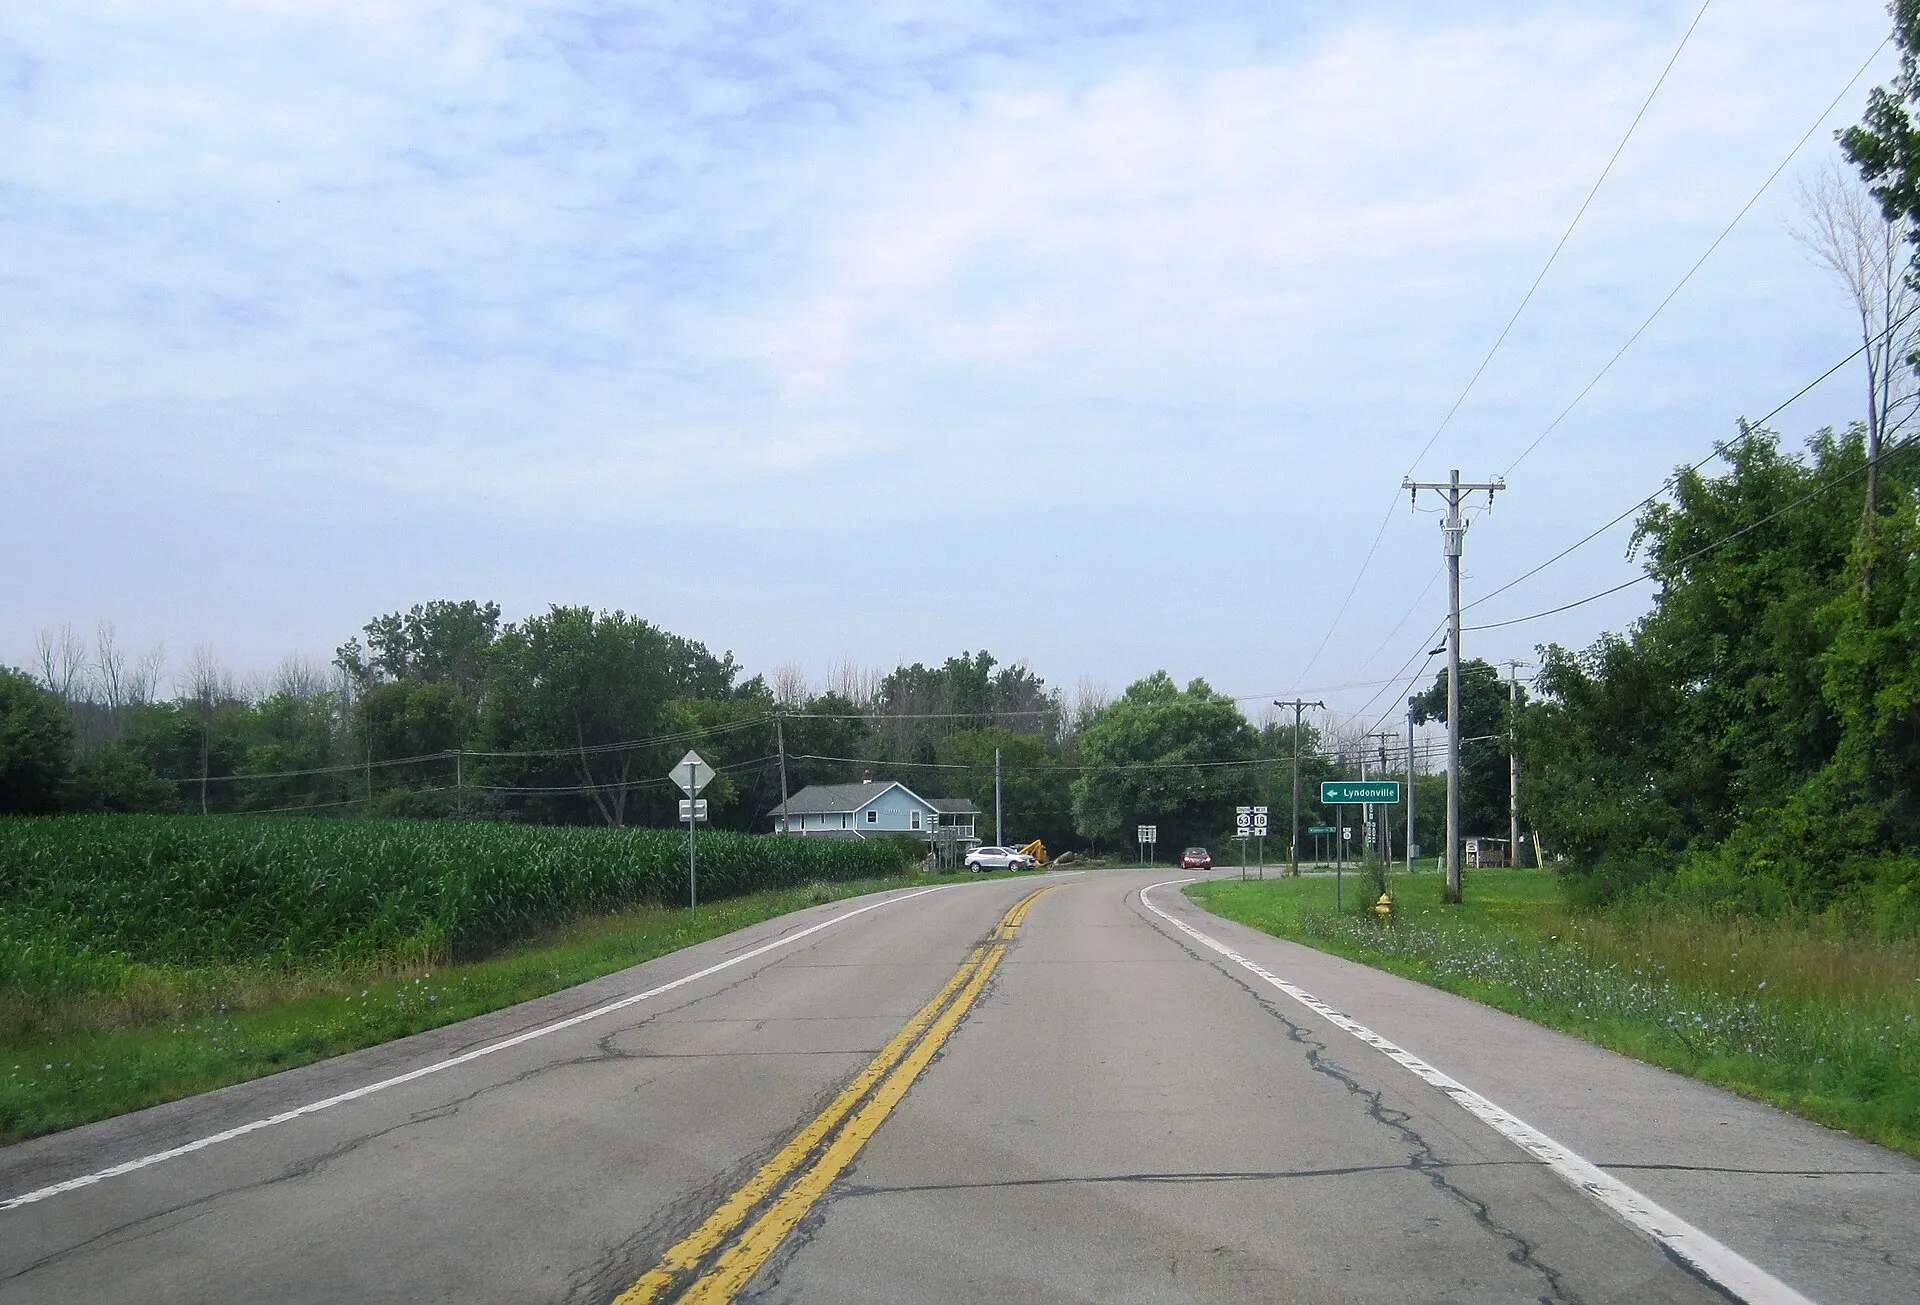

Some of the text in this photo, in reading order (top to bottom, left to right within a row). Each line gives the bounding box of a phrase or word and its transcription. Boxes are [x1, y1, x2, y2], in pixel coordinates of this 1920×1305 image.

[1343, 788, 1394, 798] Lyndonville
[1238, 816, 1249, 824] 63
[1256, 816, 1265, 824] 18
